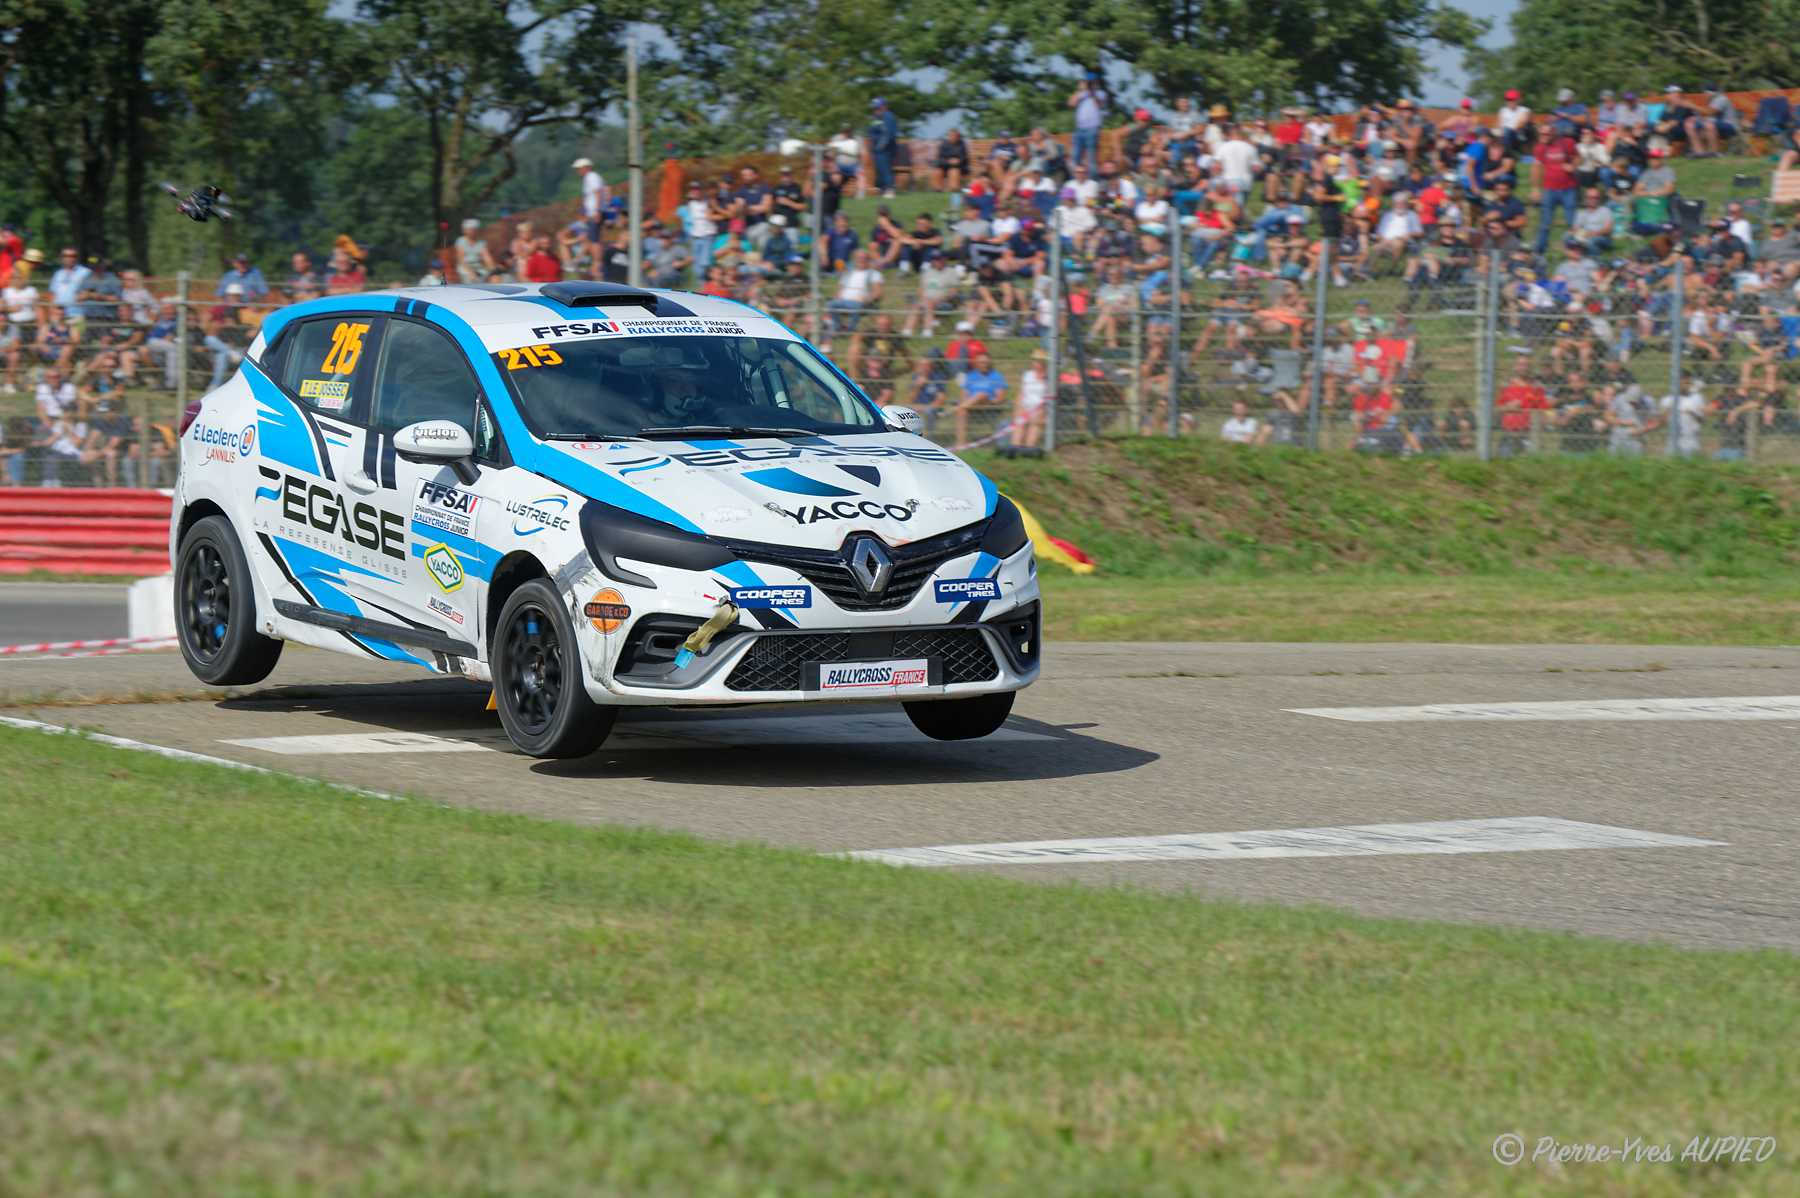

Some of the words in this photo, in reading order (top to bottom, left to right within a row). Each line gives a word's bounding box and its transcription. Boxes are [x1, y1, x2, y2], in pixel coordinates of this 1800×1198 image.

[532, 322, 611, 339] FFSA
[622, 319, 689, 327] CHAMPIONNAT
[690, 319, 702, 327] DE
[703, 320, 740, 328] FRANCE
[628, 326, 705, 335] RALLYCROSS
[707, 327, 746, 335] JUNIOR
[320, 322, 371, 375] 215
[498, 344, 564, 371] 215
[193, 424, 239, 448] E.Leclerc
[206, 448, 236, 463] LANNILIS
[419, 481, 469, 513] FFSA
[506, 500, 570, 531] LUSTRELEC
[784, 500, 913, 525] YACCO
[414, 512, 450, 530] RALLYCROSS
[450, 523, 469, 535] JUNIOR
[430, 557, 459, 580] YACCO
[736, 590, 806, 599] COOPER
[939, 582, 995, 593] COOPER
[967, 590, 995, 598] TIRES
[828, 668, 892, 685] RALLYCROSS
[894, 670, 924, 684] FRANCE
